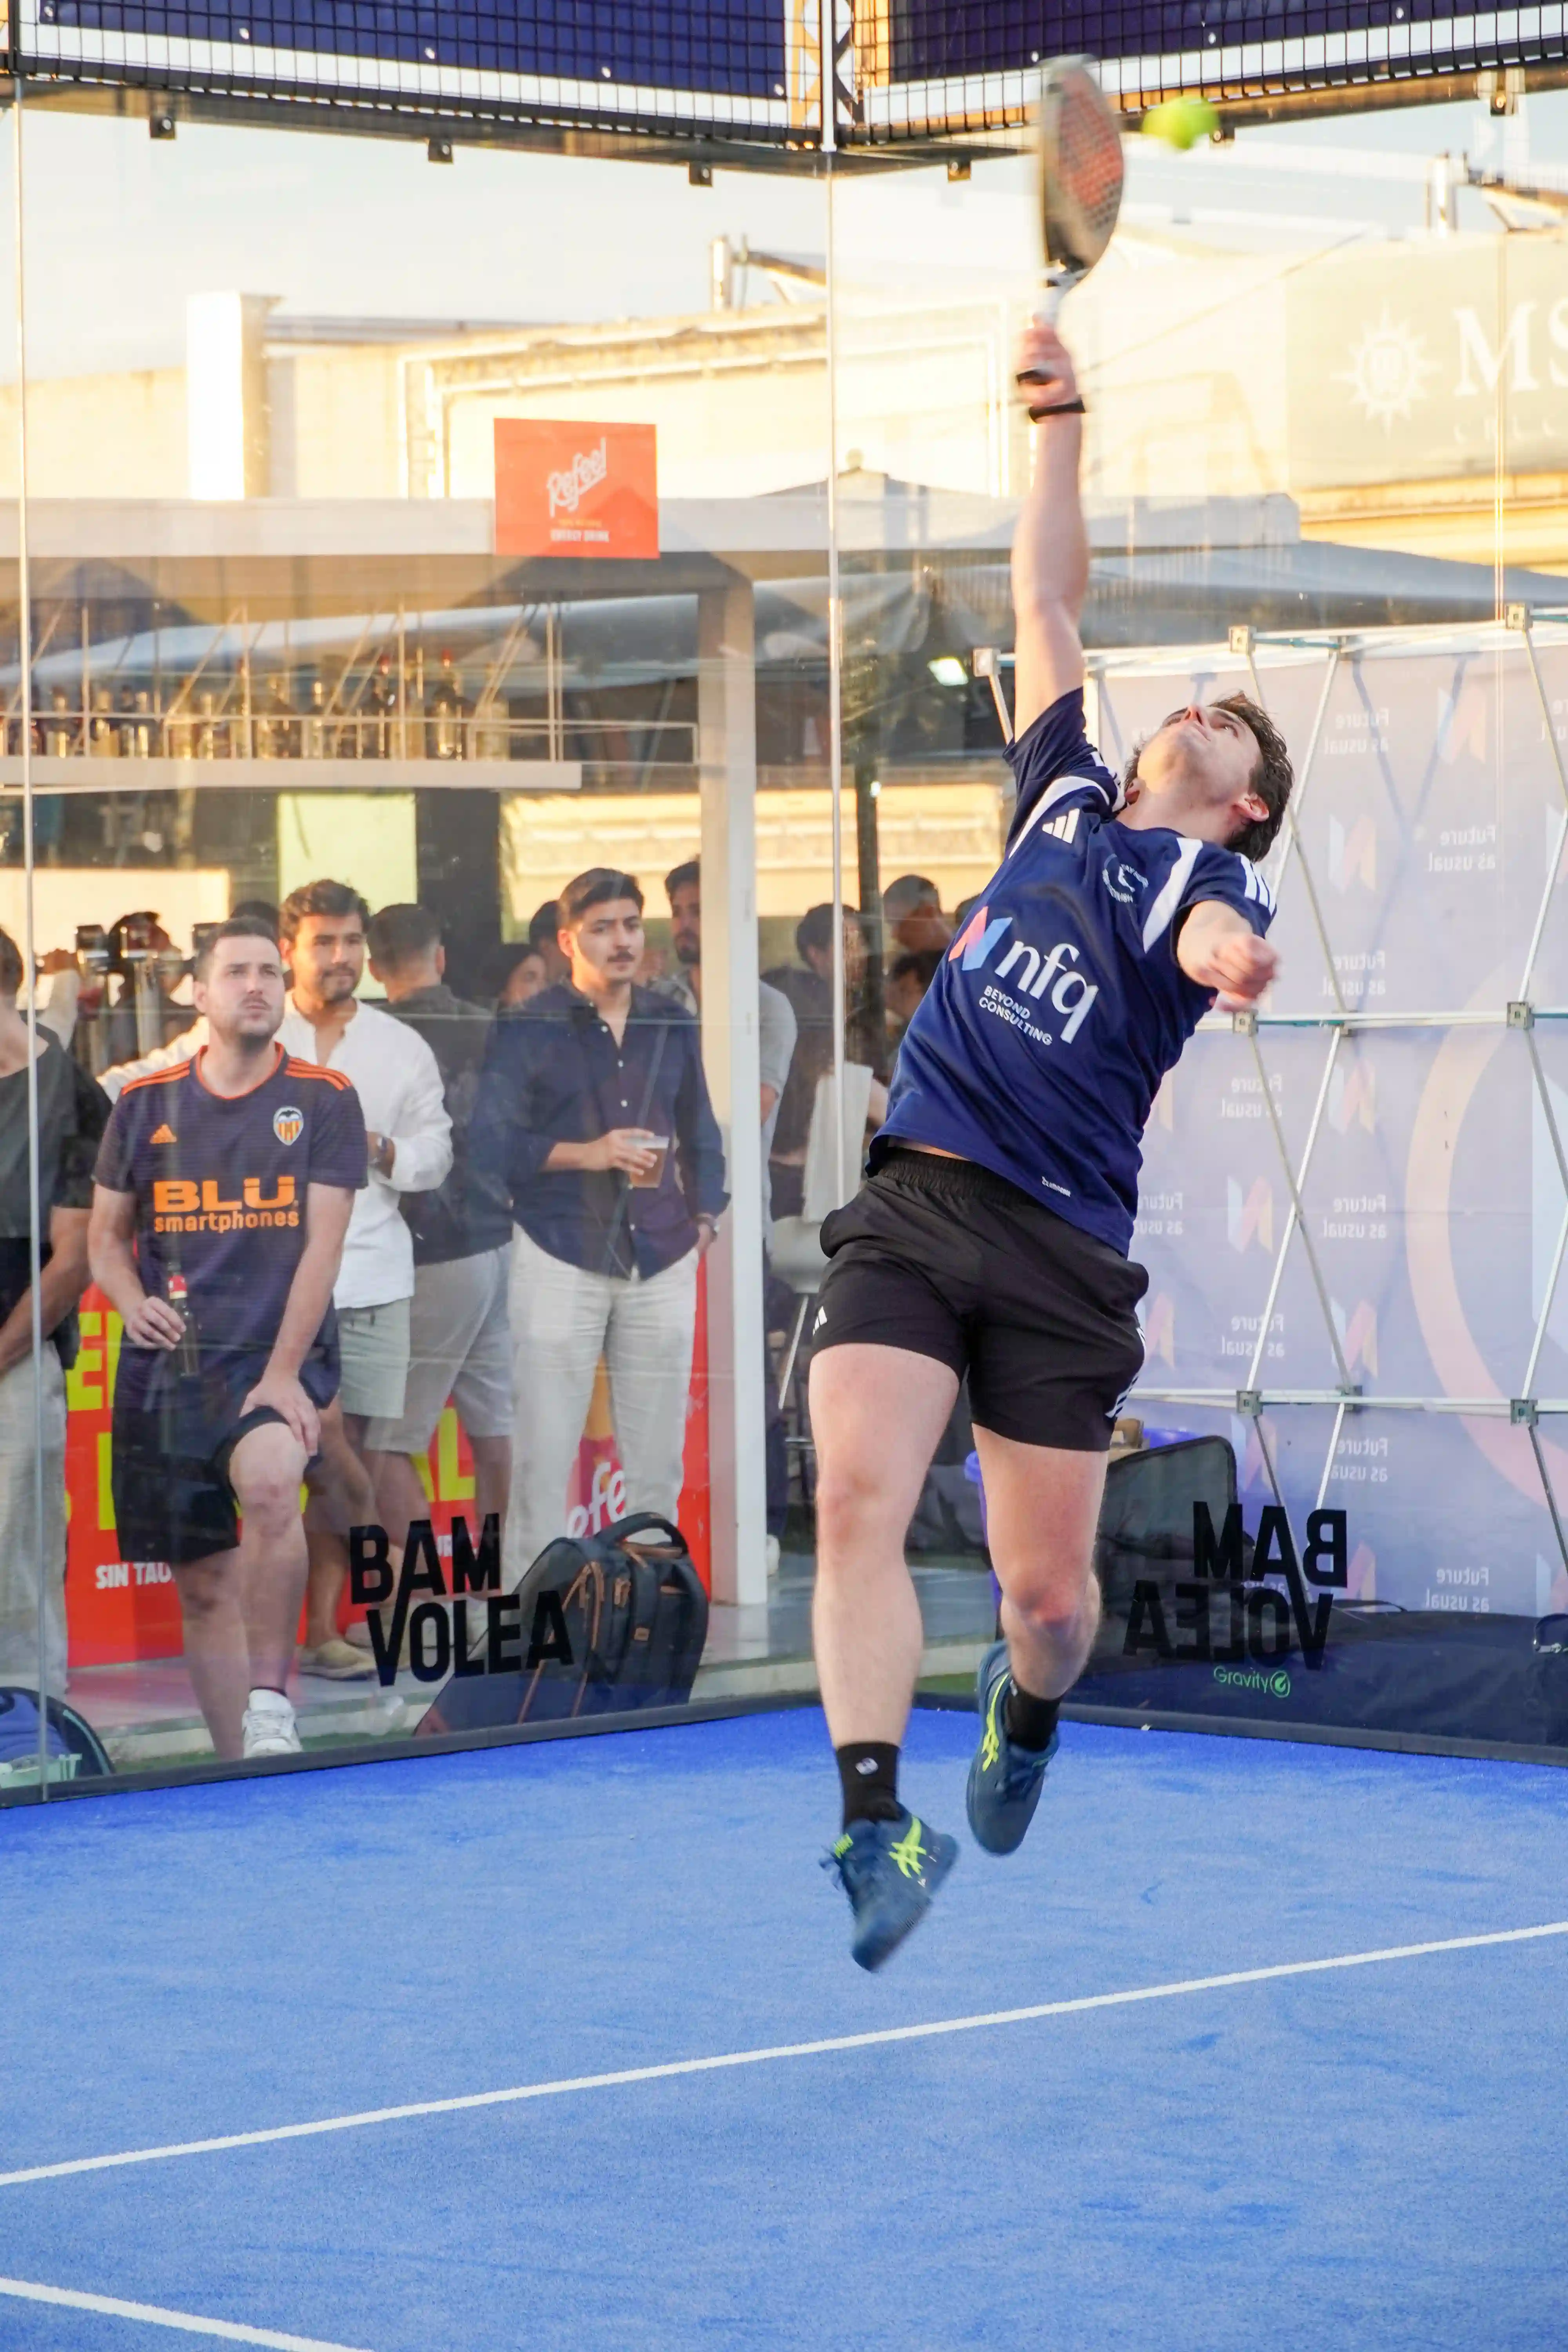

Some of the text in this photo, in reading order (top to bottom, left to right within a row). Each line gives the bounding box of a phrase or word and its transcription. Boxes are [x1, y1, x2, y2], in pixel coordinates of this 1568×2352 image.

[984, 985, 1031, 1019] BEYOND
[995, 941, 1099, 1044] nfq
[979, 998, 1053, 1045] CONSULTING
[153, 1176, 295, 1212] BLU
[153, 1210, 299, 1233] smartphones
[96, 1562, 172, 1589] SIN TAU
[349, 1513, 500, 1605] BAM
[366, 1590, 575, 1687] VOLEA
[1214, 1665, 1268, 1693] Gravity
